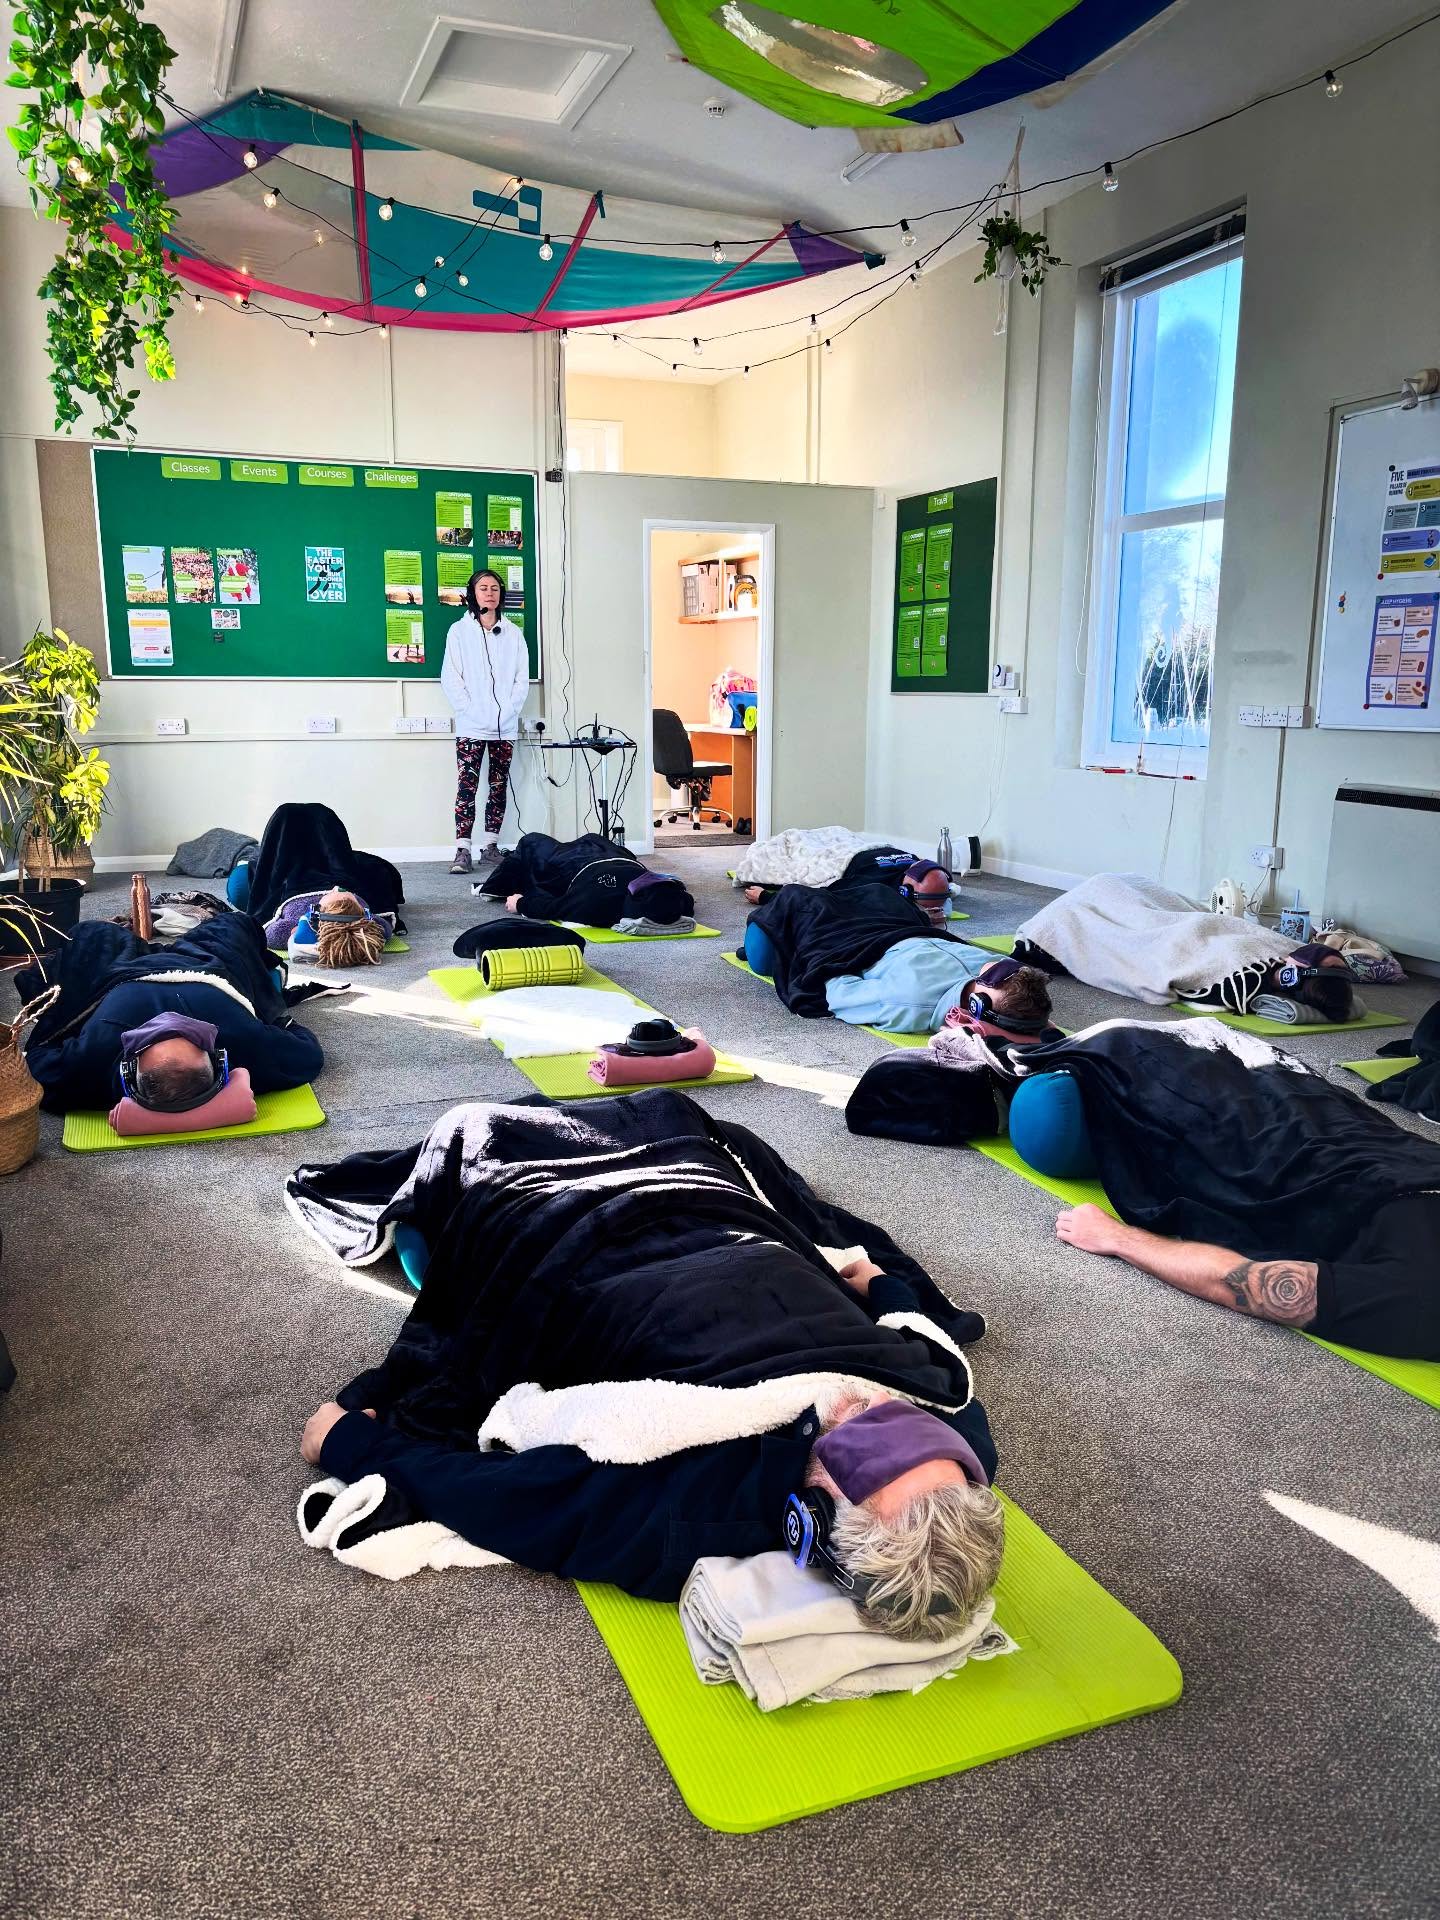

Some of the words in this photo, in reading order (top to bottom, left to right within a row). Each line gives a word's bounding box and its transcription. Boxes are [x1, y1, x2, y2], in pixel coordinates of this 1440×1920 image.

[171, 461, 211, 475] Classes
[242, 464, 278, 478] Events
[306, 467, 347, 480] Courses
[364, 470, 418, 484] Challenges
[1391, 471, 1405, 482] FIVE
[934, 496, 948, 508] Travel
[1388, 508, 1394, 517] 2
[1421, 504, 1427, 513] 3
[1384, 537, 1389, 546] 4
[316, 548, 333, 557] THE
[306, 556, 344, 565] FASTER
[1383, 560, 1389, 569] 5
[307, 564, 331, 573] YOU
[328, 582, 343, 590] IT'S
[310, 590, 343, 601] OVER
